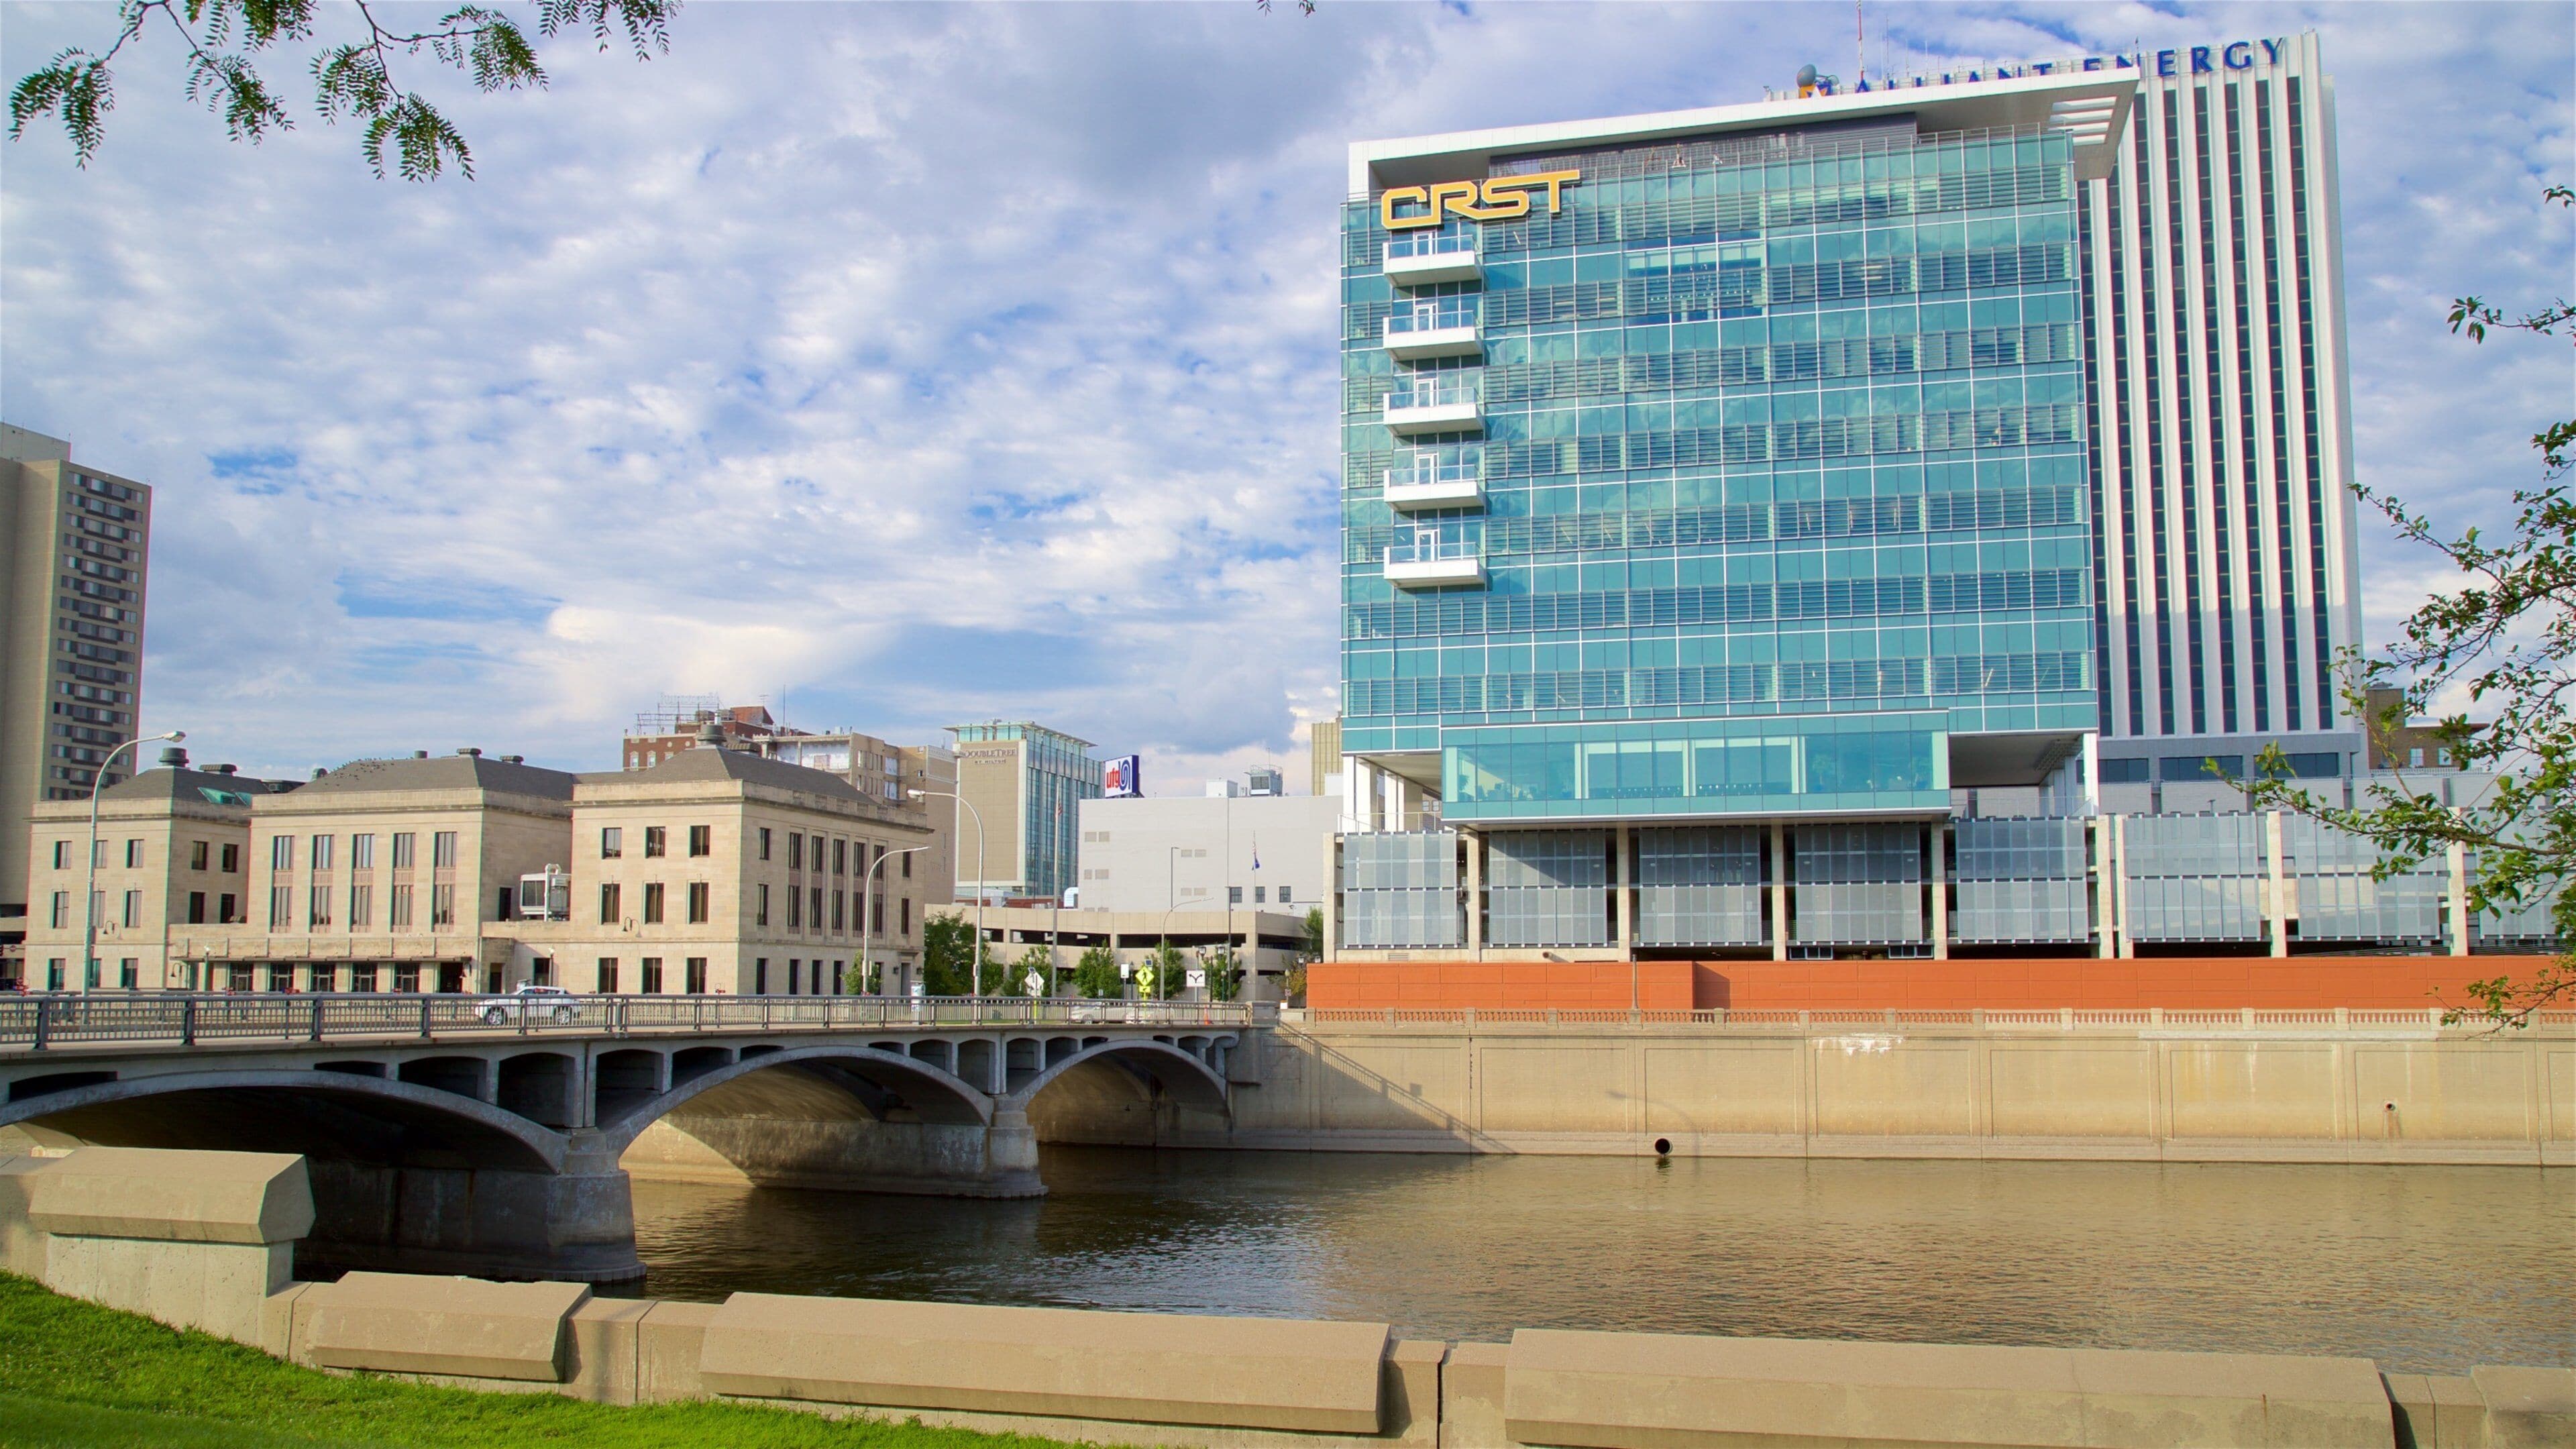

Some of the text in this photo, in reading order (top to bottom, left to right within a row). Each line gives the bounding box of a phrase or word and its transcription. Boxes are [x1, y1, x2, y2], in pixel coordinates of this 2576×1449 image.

[2083, 37, 2283, 76] ENERGY
[1381, 169, 1580, 230] CRST
[1106, 767, 1120, 789] ufg
